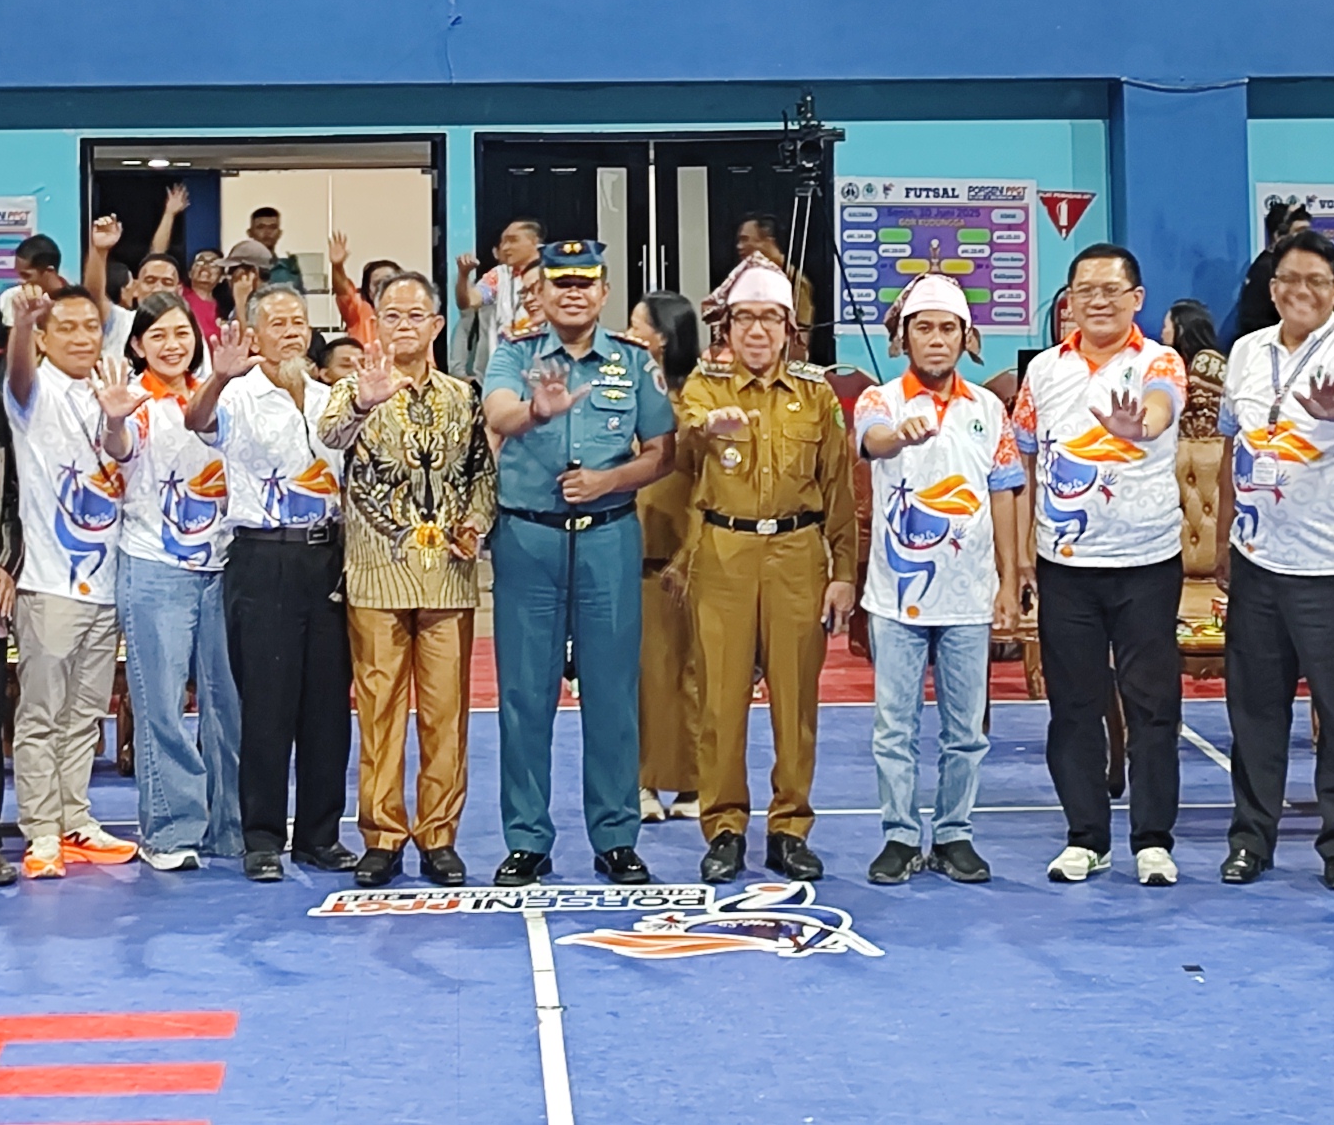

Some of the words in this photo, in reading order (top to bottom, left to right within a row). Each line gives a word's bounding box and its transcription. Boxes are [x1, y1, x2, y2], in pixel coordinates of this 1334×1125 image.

[904, 187, 960, 199] FUTSAL
[320, 899, 462, 913] PPGT
[471, 895, 706, 910] PORSENI
